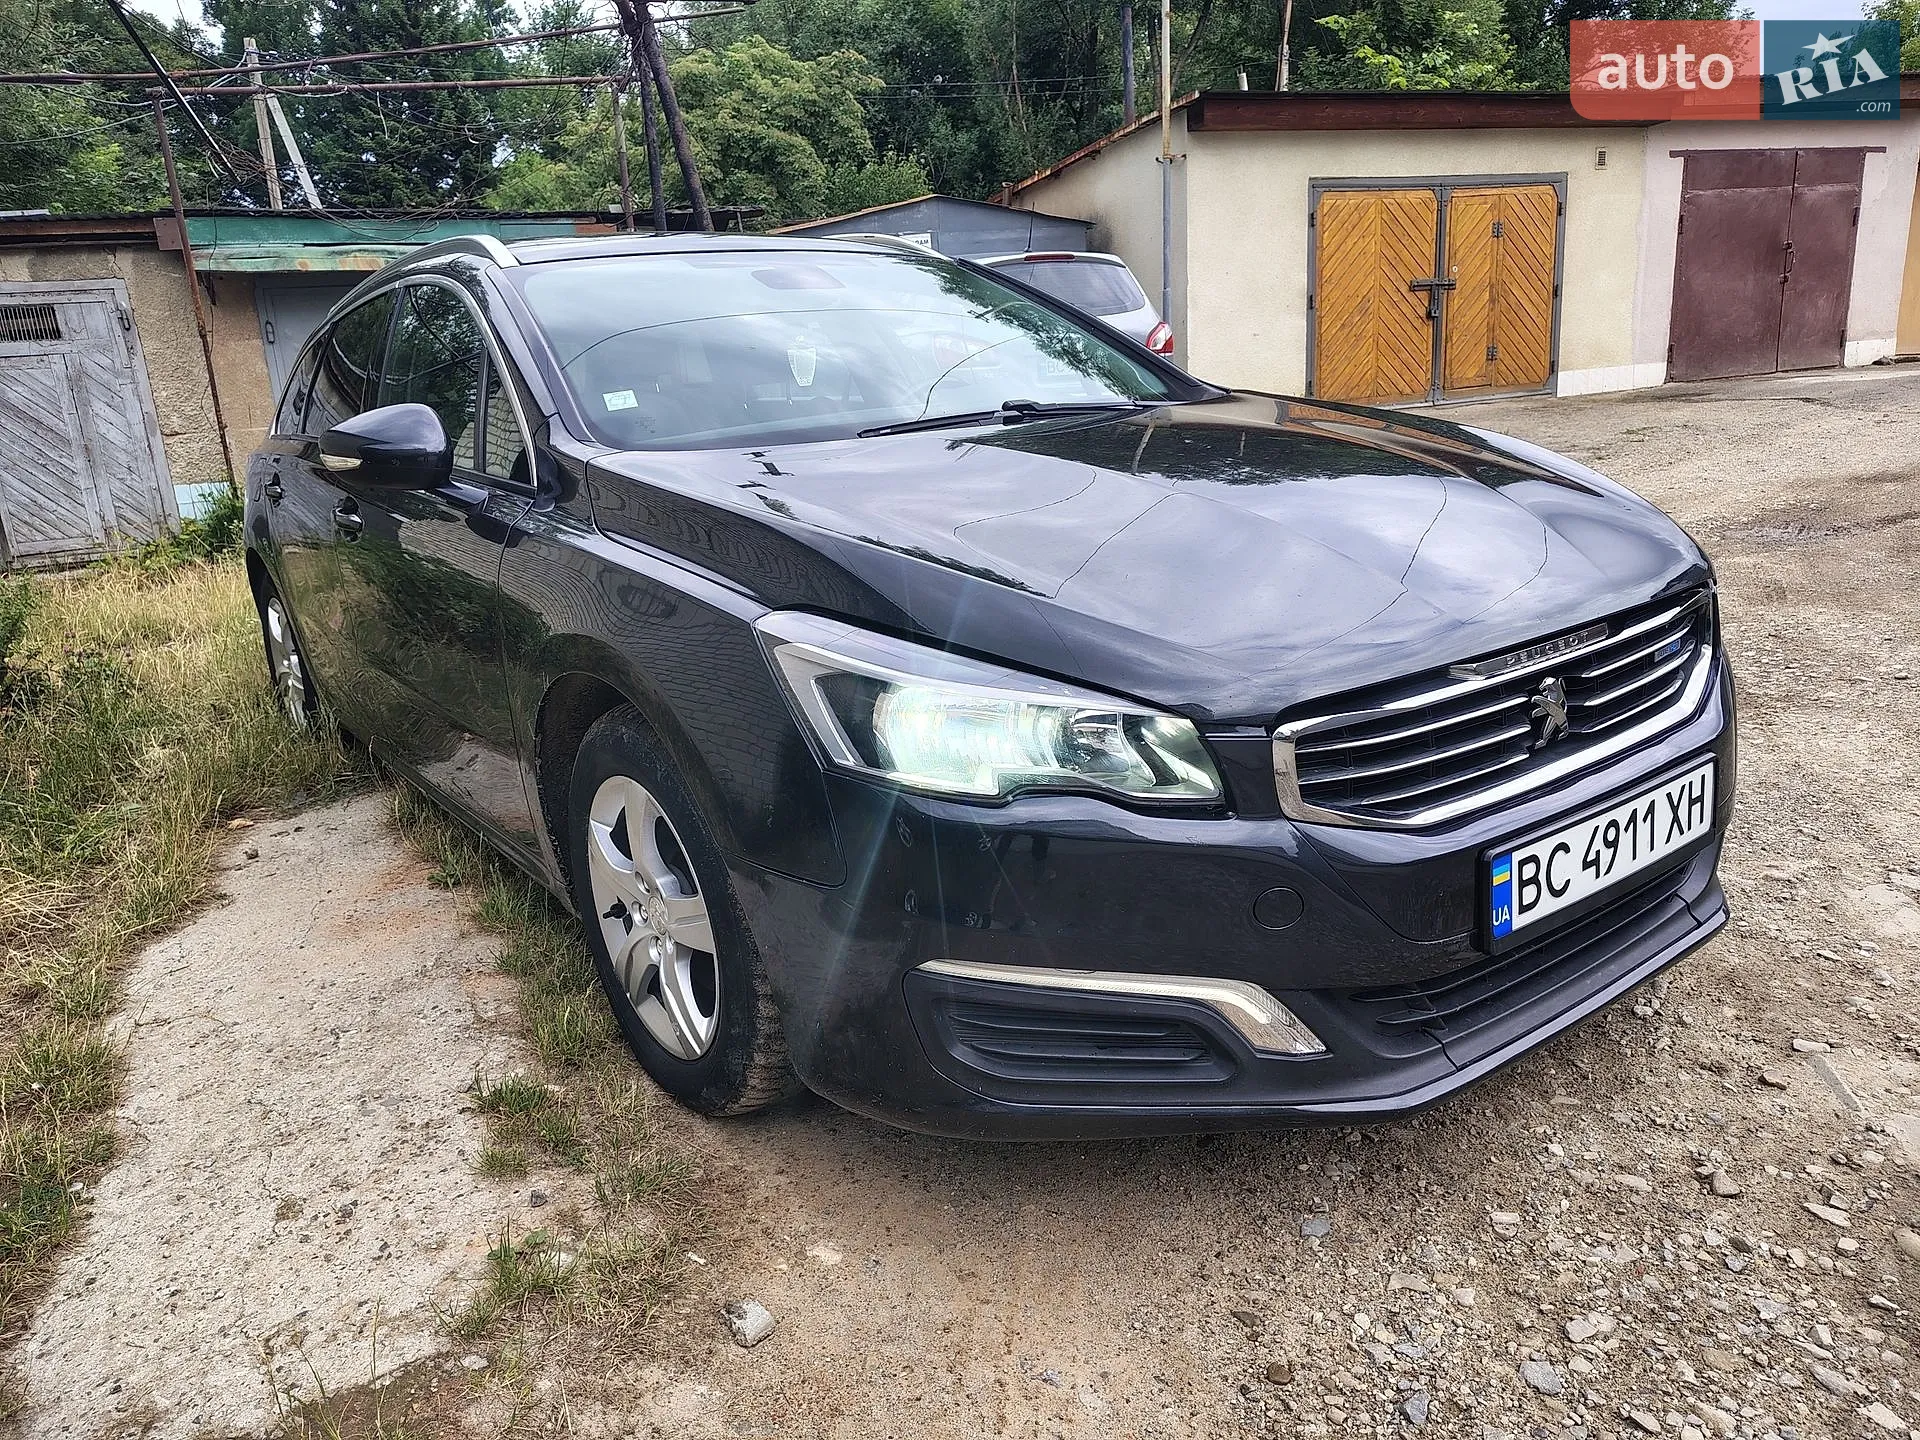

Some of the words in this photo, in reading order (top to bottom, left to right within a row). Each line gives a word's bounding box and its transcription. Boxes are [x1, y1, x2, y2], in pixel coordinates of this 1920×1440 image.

[1506, 632, 1588, 667] PEUGEOT
[1517, 841, 1571, 915] BC
[1582, 798, 1655, 880] 4911
[1665, 773, 1706, 845] XH
[1493, 905, 1510, 926] UA
